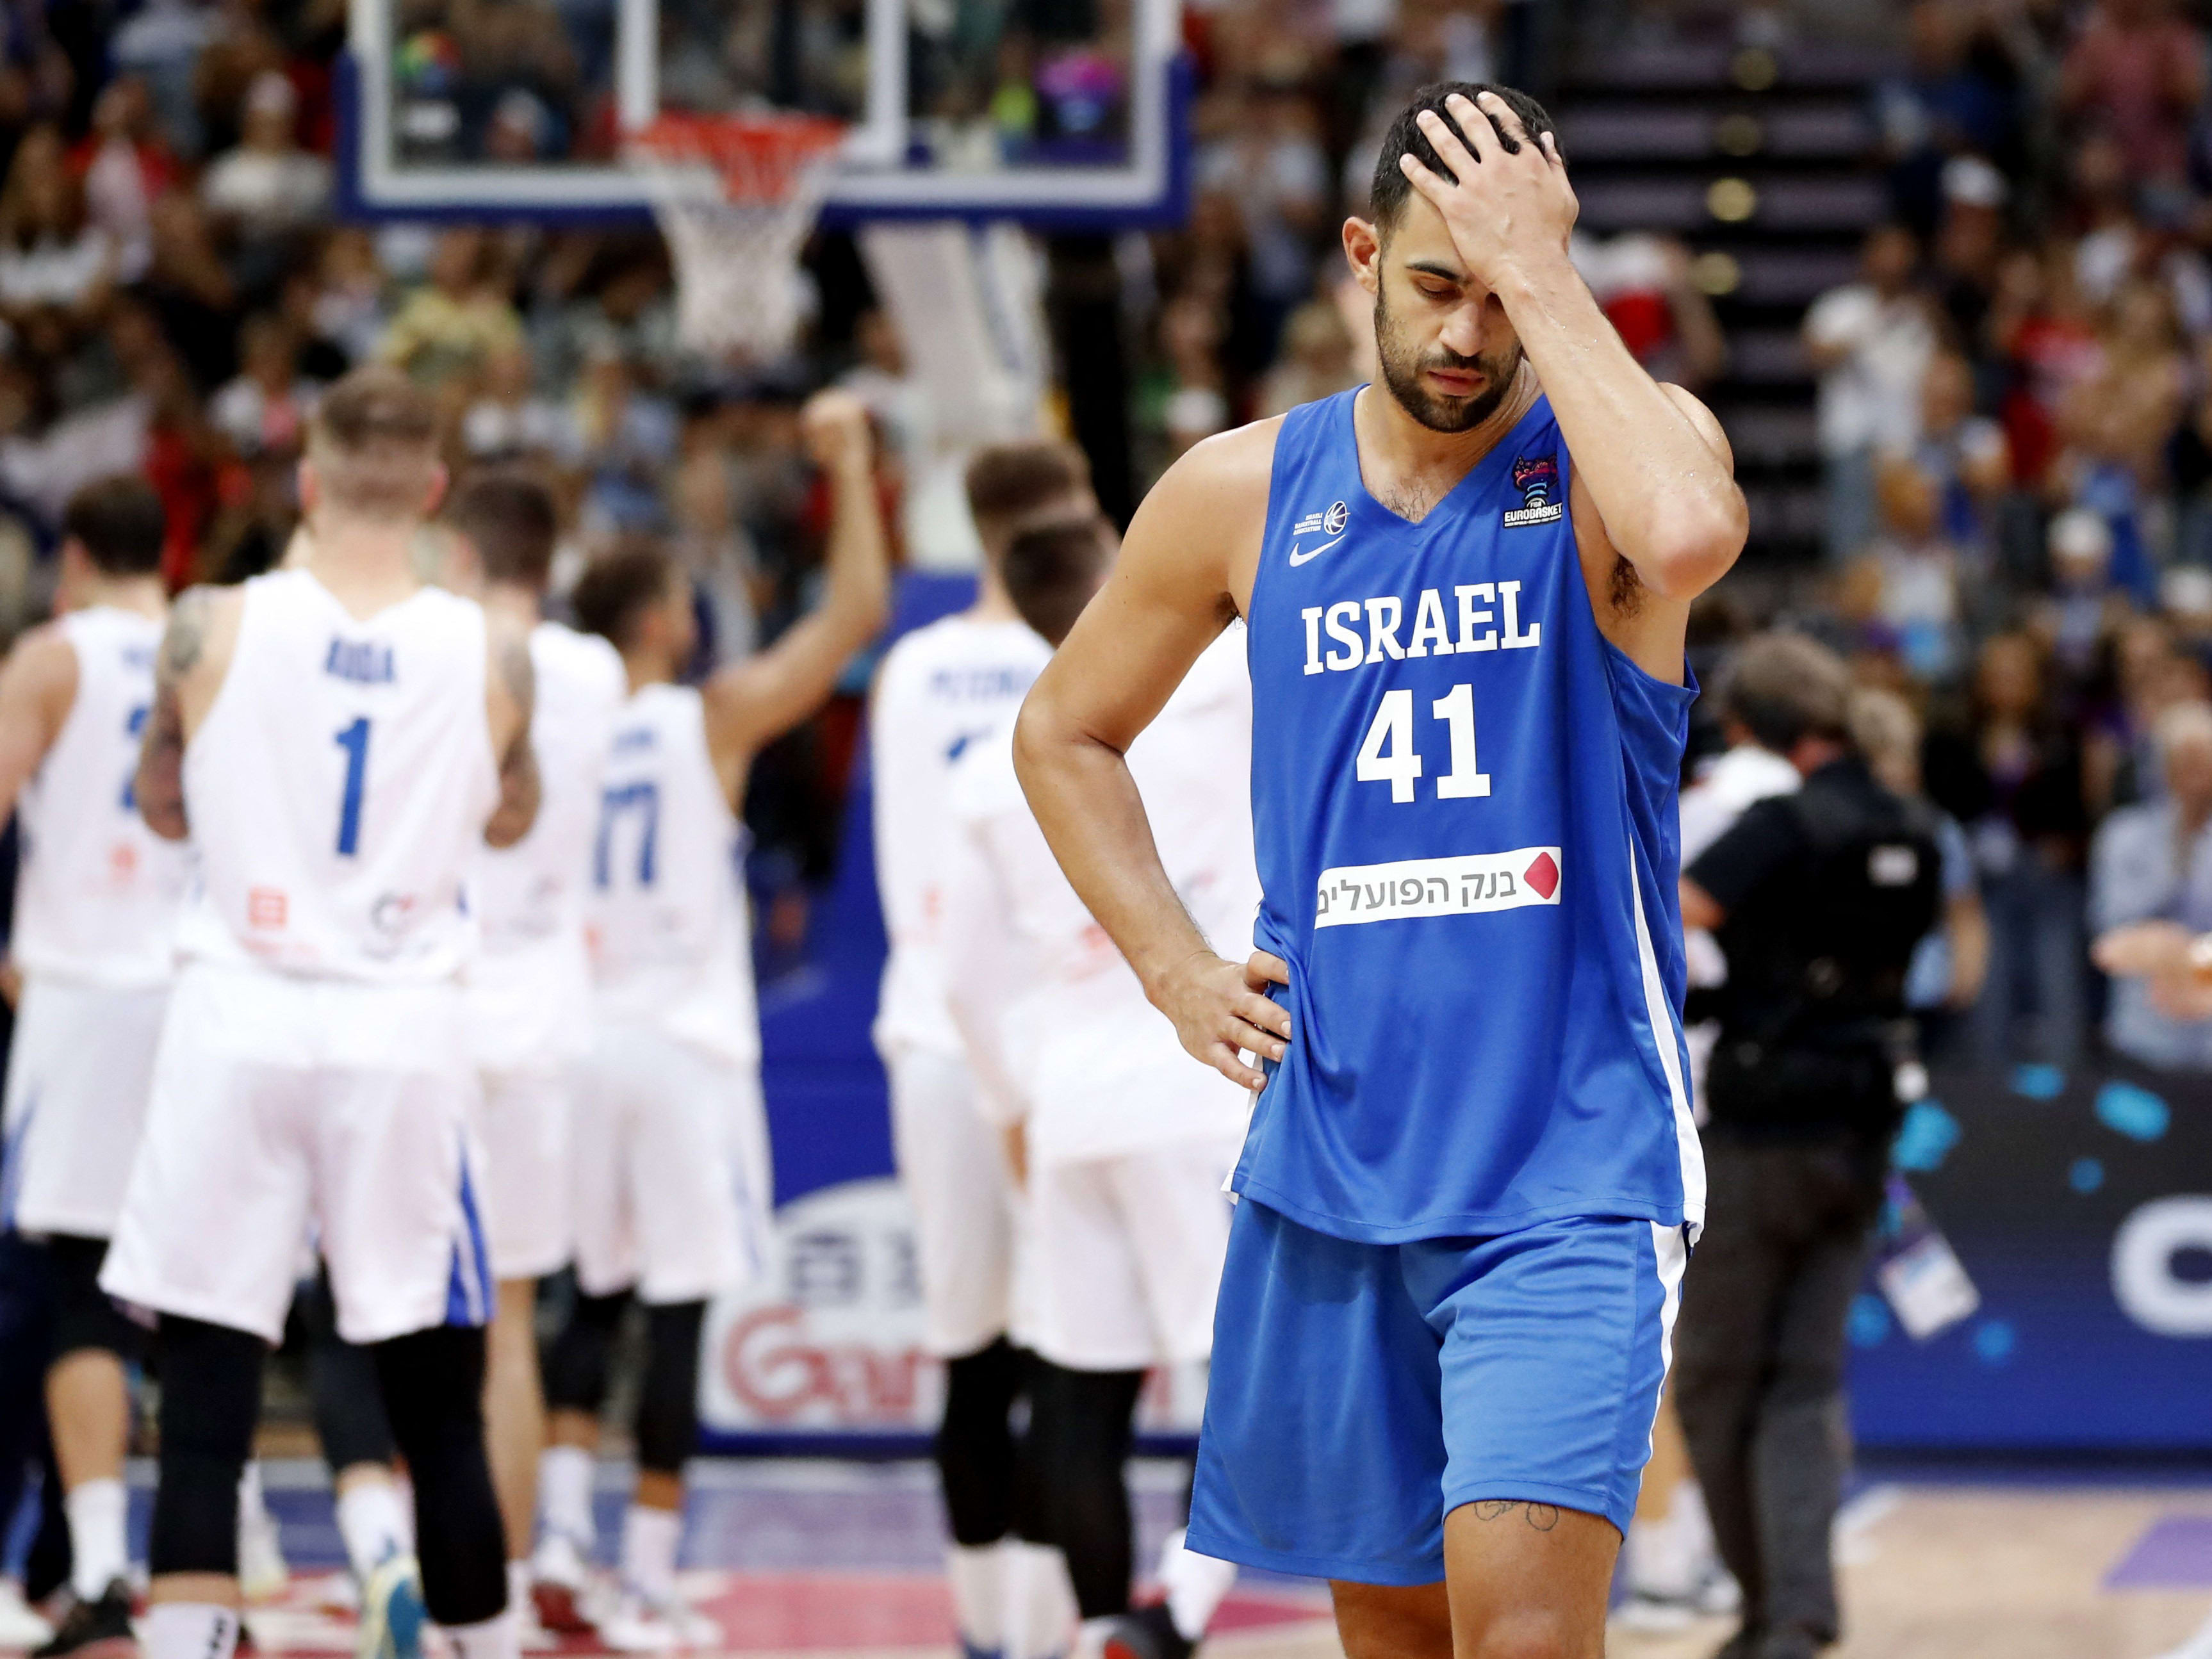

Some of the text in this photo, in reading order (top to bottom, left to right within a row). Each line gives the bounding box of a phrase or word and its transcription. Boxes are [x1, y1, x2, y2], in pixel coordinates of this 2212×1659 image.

[1504, 503, 1562, 522] EUROBASKET
[1301, 580, 1541, 675] ISRAEL
[334, 717, 370, 856] 1
[1356, 683, 1491, 804] 41
[1316, 870, 1516, 915] בנק הפועלים
